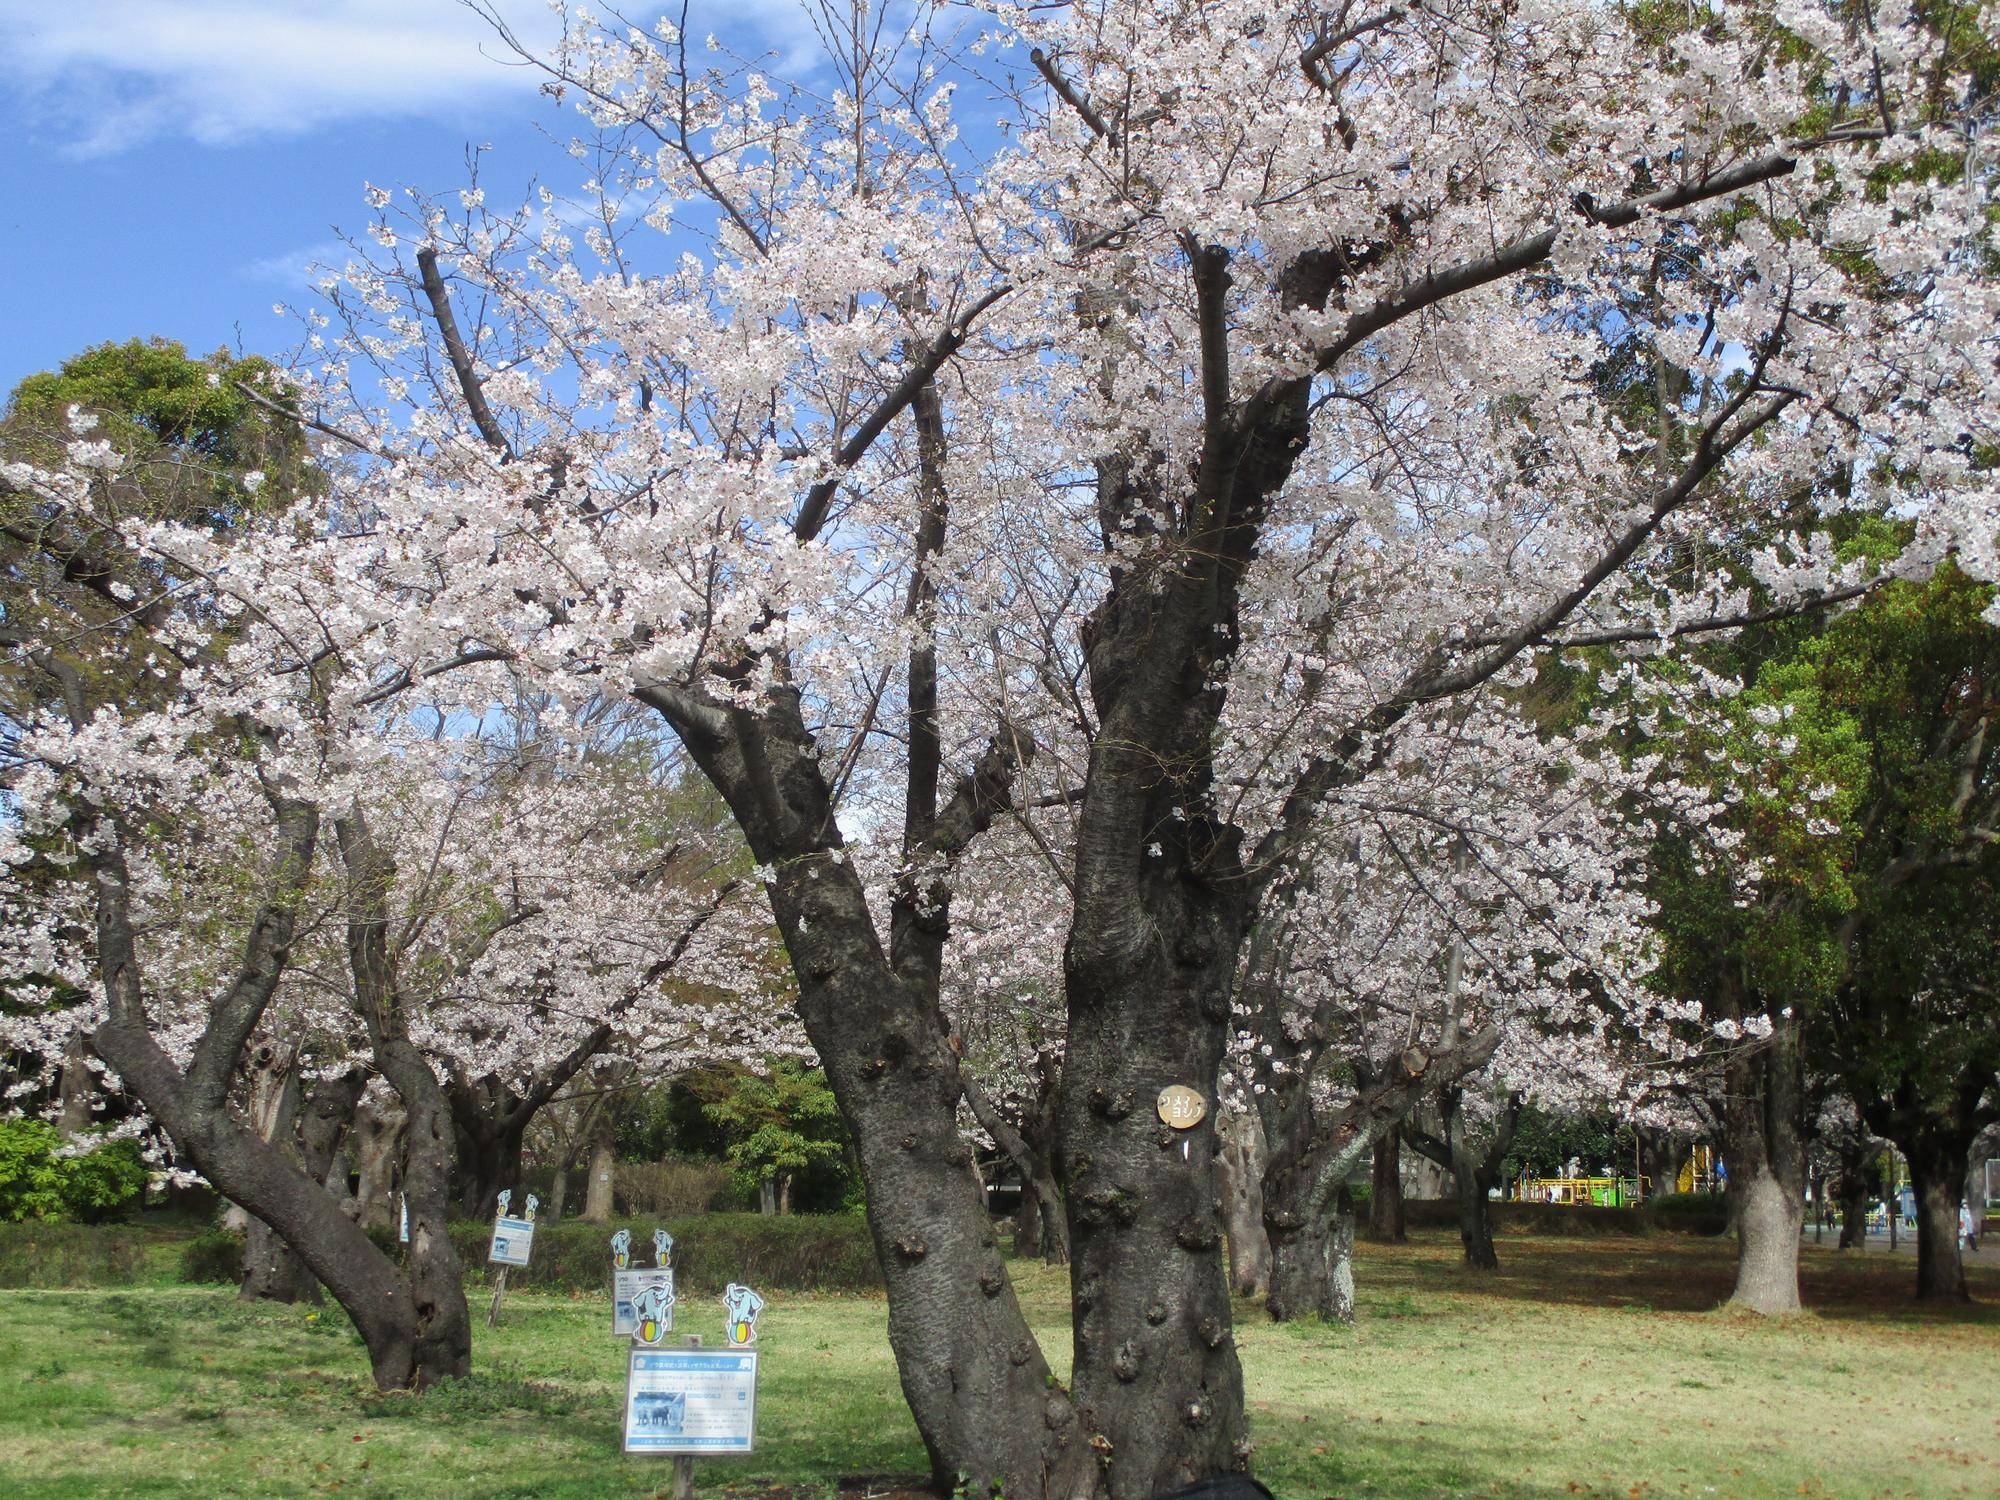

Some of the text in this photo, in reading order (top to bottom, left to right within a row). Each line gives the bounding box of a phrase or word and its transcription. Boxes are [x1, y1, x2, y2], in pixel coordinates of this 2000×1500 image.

[1161, 1095, 1191, 1108] ソメイ
[1172, 1106, 1202, 1118] ヨシノ
